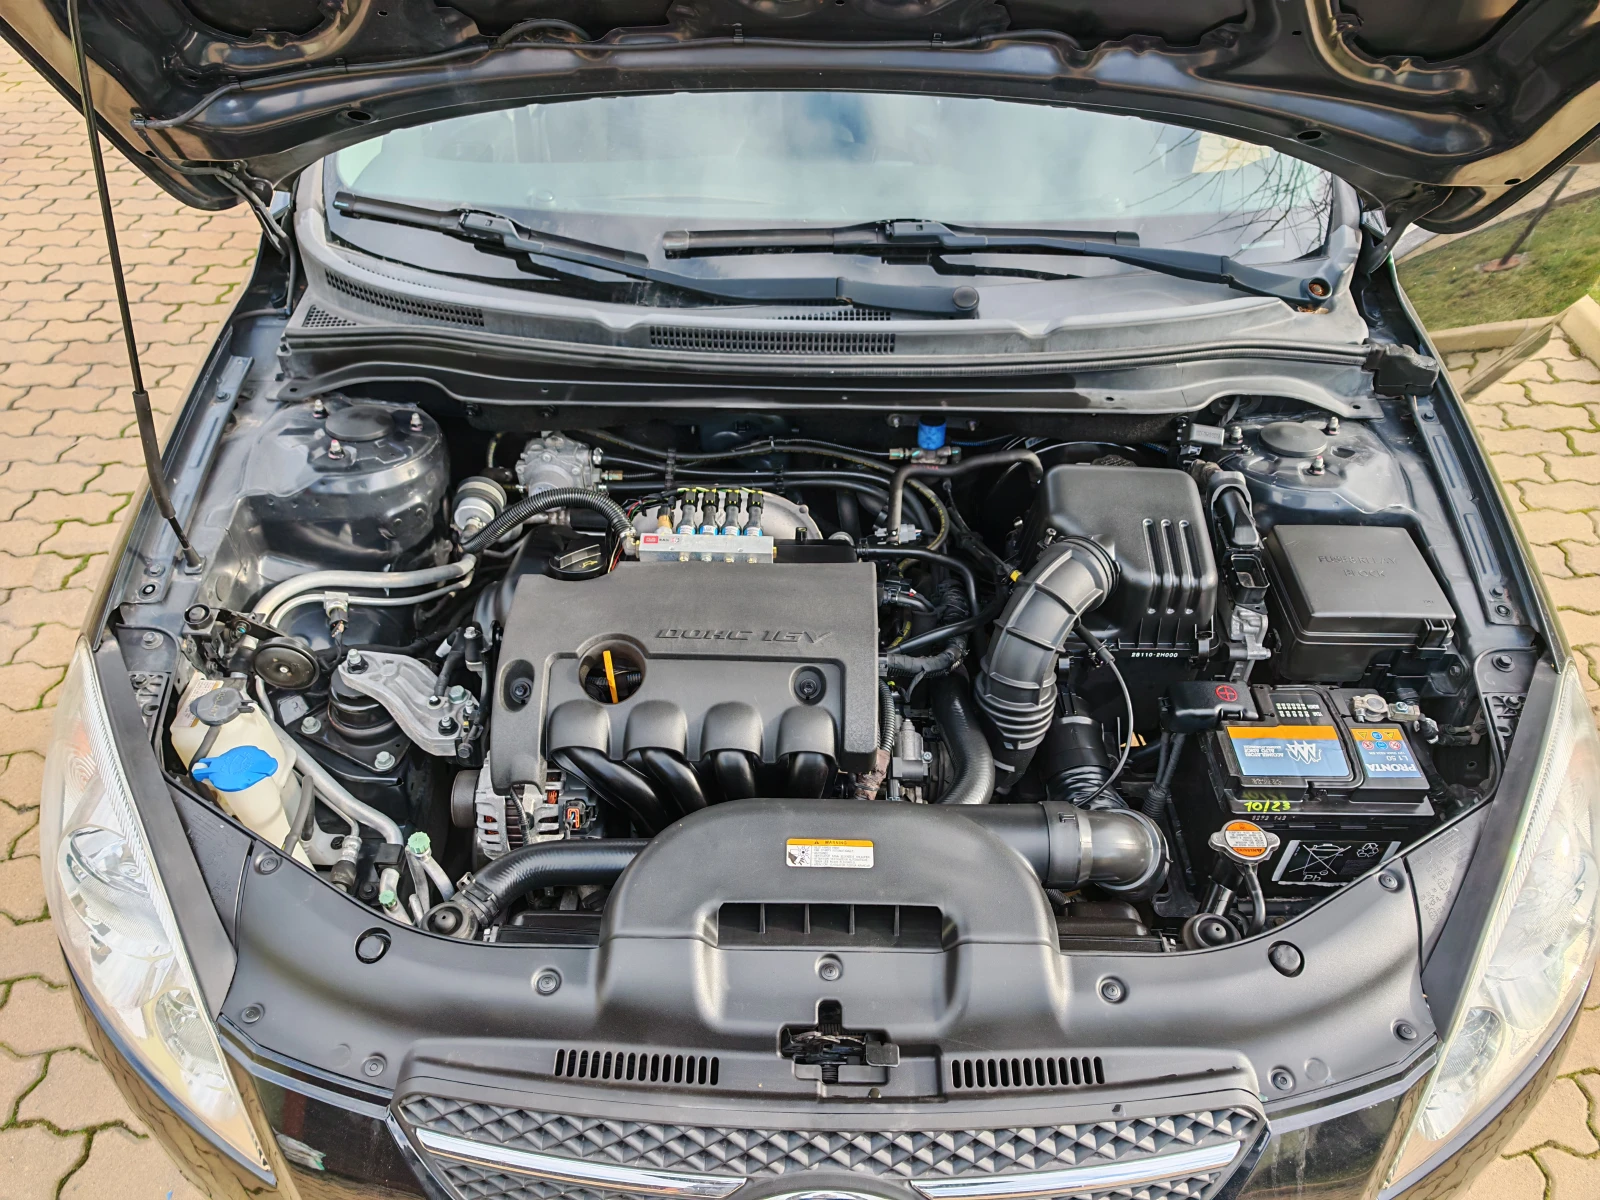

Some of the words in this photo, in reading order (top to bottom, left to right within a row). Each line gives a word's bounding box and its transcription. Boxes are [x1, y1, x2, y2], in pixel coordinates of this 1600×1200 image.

[655, 628, 752, 641] DOHC
[1366, 763, 1417, 772] PRONTA
[1243, 799, 1291, 814] 10/23
[1302, 874, 1321, 882] Pb
